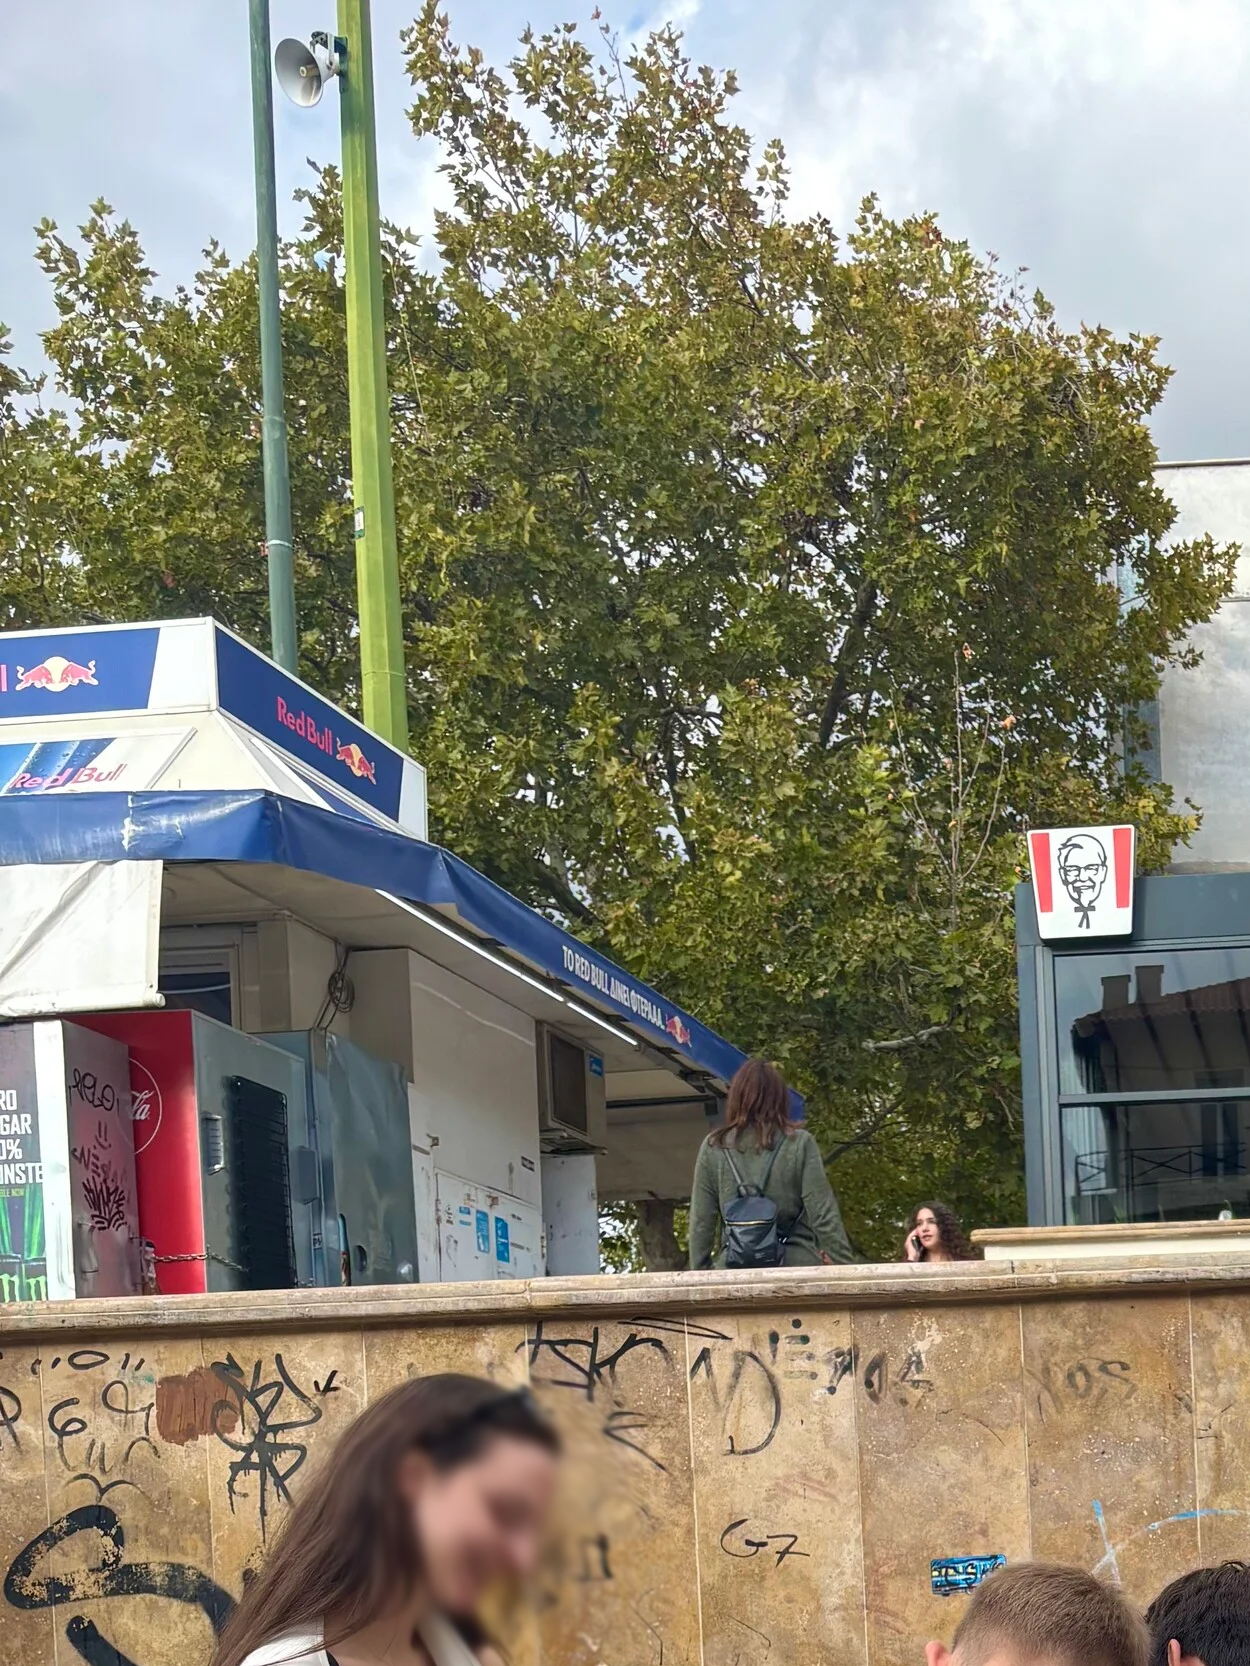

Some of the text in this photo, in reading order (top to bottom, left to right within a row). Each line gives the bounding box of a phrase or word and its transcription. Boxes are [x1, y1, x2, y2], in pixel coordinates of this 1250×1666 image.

[277, 696, 333, 756] Red Bull
[9, 763, 128, 789] Red Bull
[574, 953, 590, 982] RED
[591, 963, 609, 995] BULL
